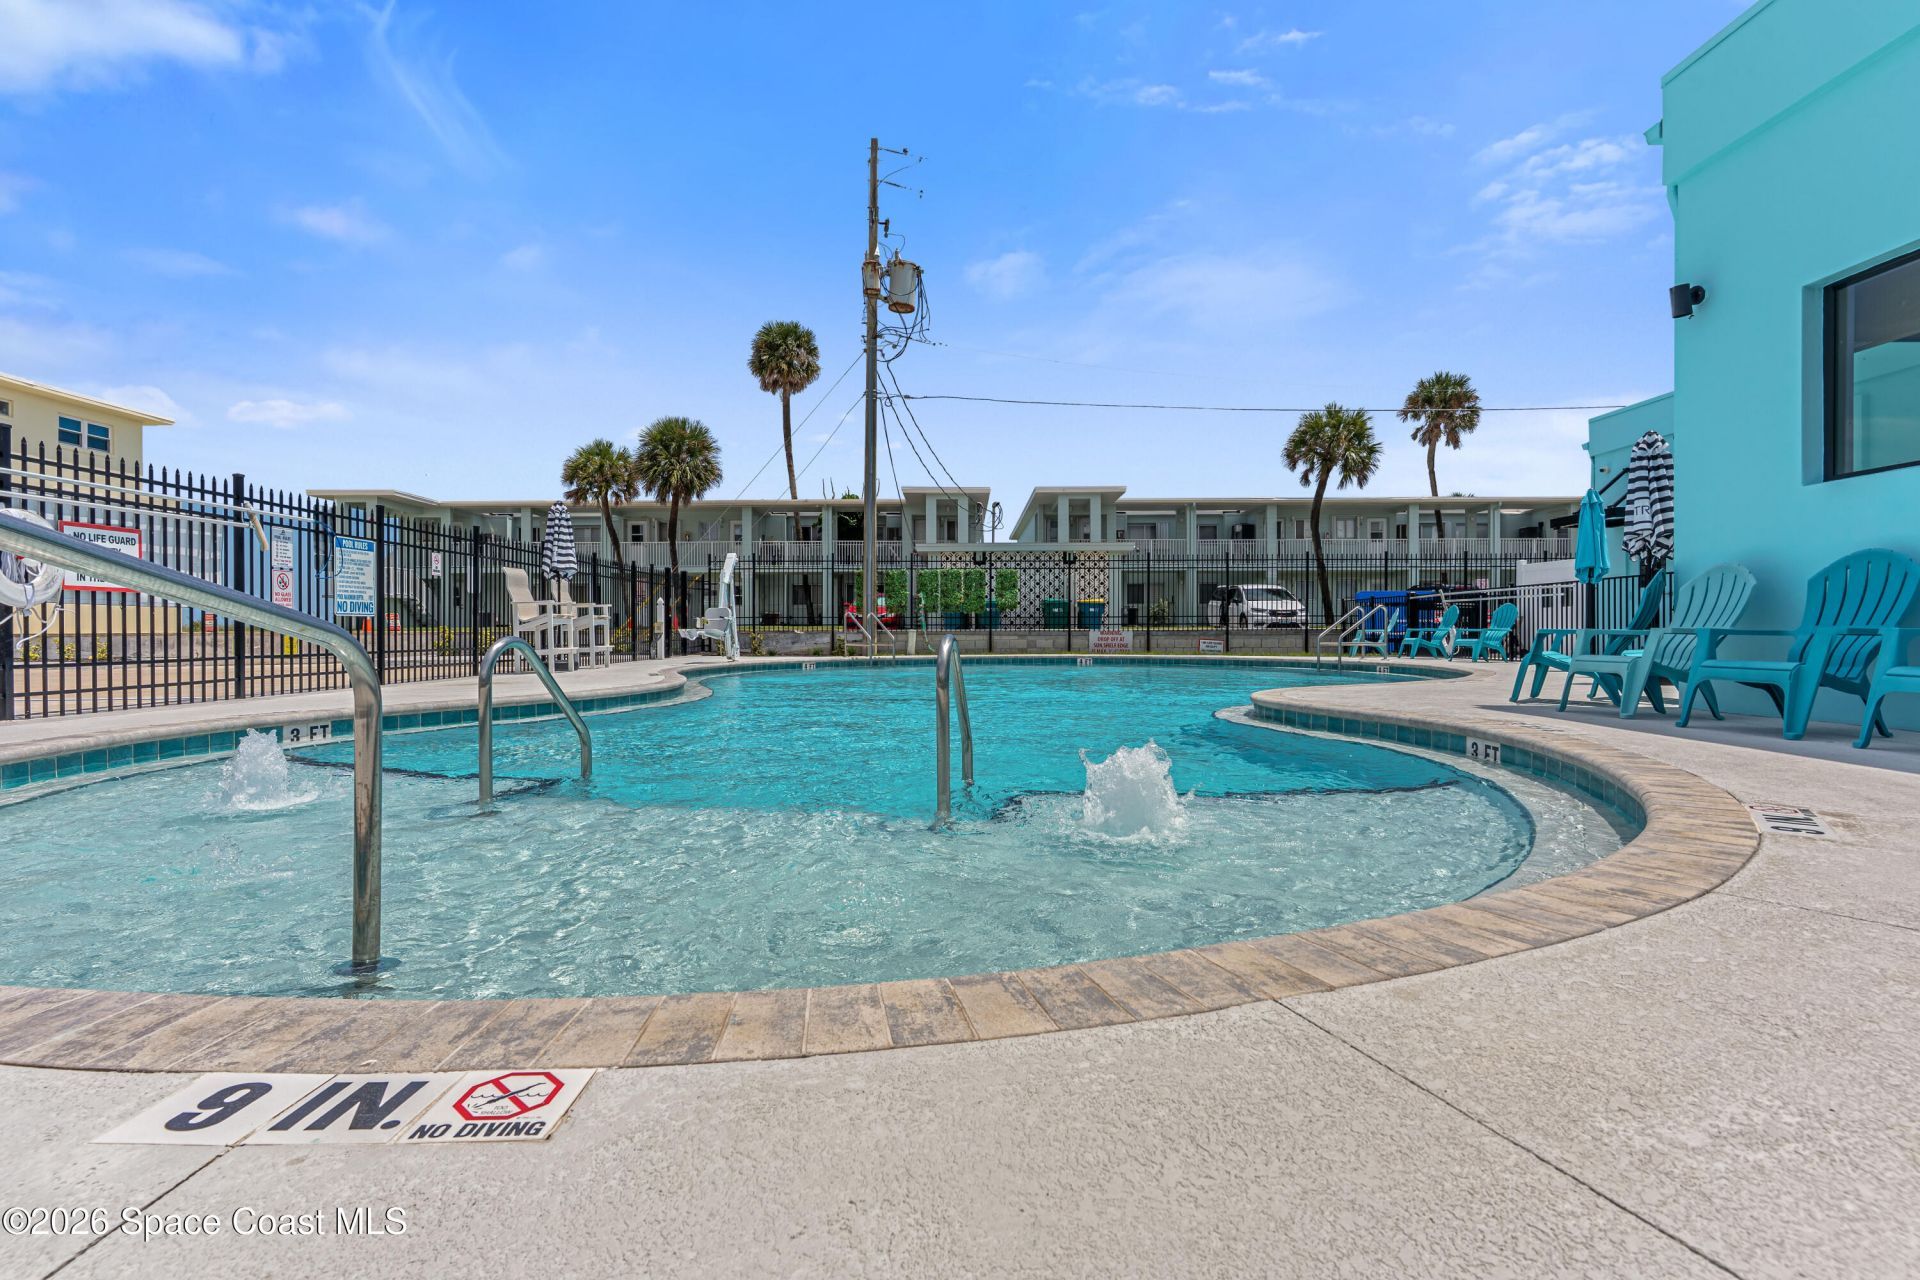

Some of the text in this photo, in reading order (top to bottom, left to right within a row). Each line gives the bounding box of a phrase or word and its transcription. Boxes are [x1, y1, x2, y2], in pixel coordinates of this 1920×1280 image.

[88, 533, 107, 543] LIFE
[108, 535, 137, 546] GUARD
[342, 539, 369, 550] POOL RULES
[77, 573, 86, 582] IN
[337, 600, 374, 613] NO DIVING
[290, 724, 329, 742] 3 FT
[1471, 741, 1499, 761] 3 FT
[164, 1080, 430, 1132] 9 IN.
[408, 1121, 546, 1139] NO DIVING
